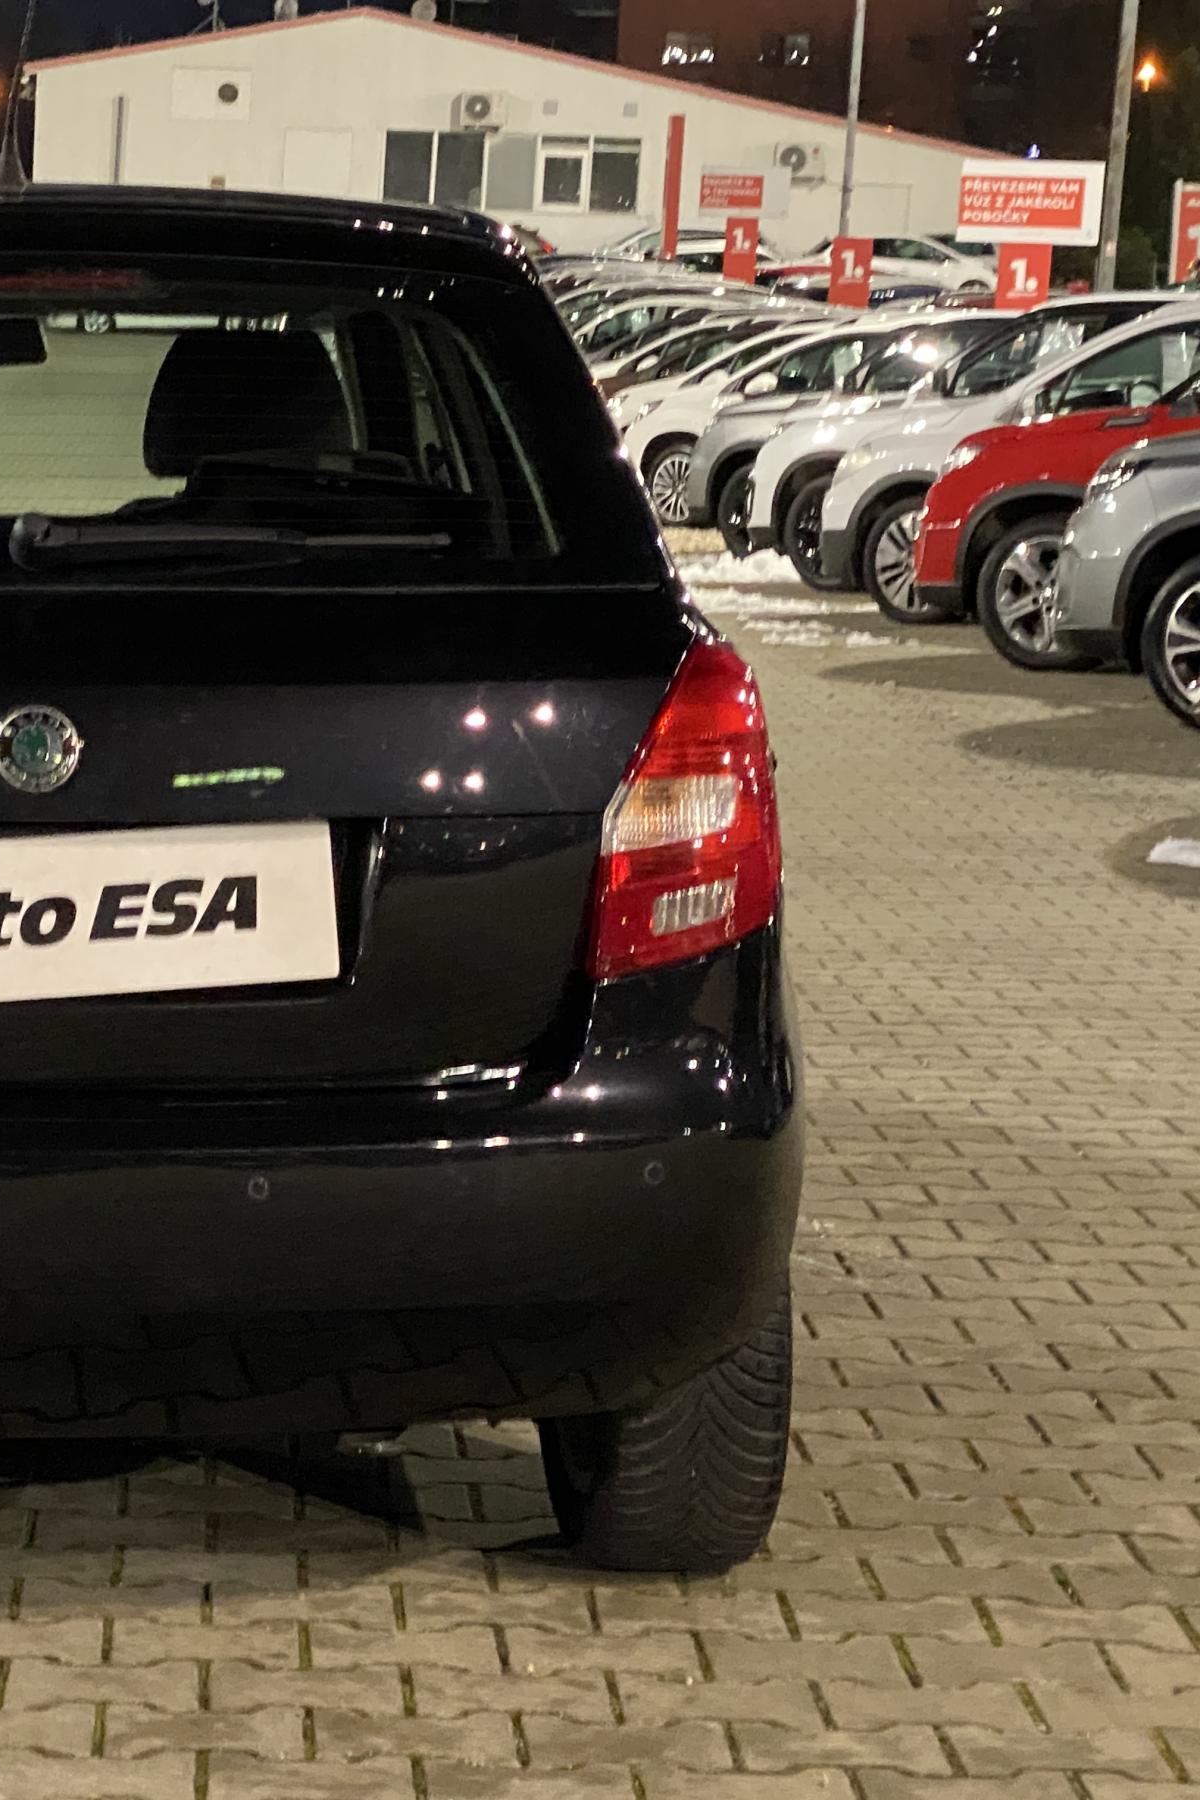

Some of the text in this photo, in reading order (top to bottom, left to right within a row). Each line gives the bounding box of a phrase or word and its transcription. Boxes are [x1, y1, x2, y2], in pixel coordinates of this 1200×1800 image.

[840, 249, 864, 279] 1.
[1010, 257, 1038, 292] 1.
[89, 876, 258, 940] ESA
